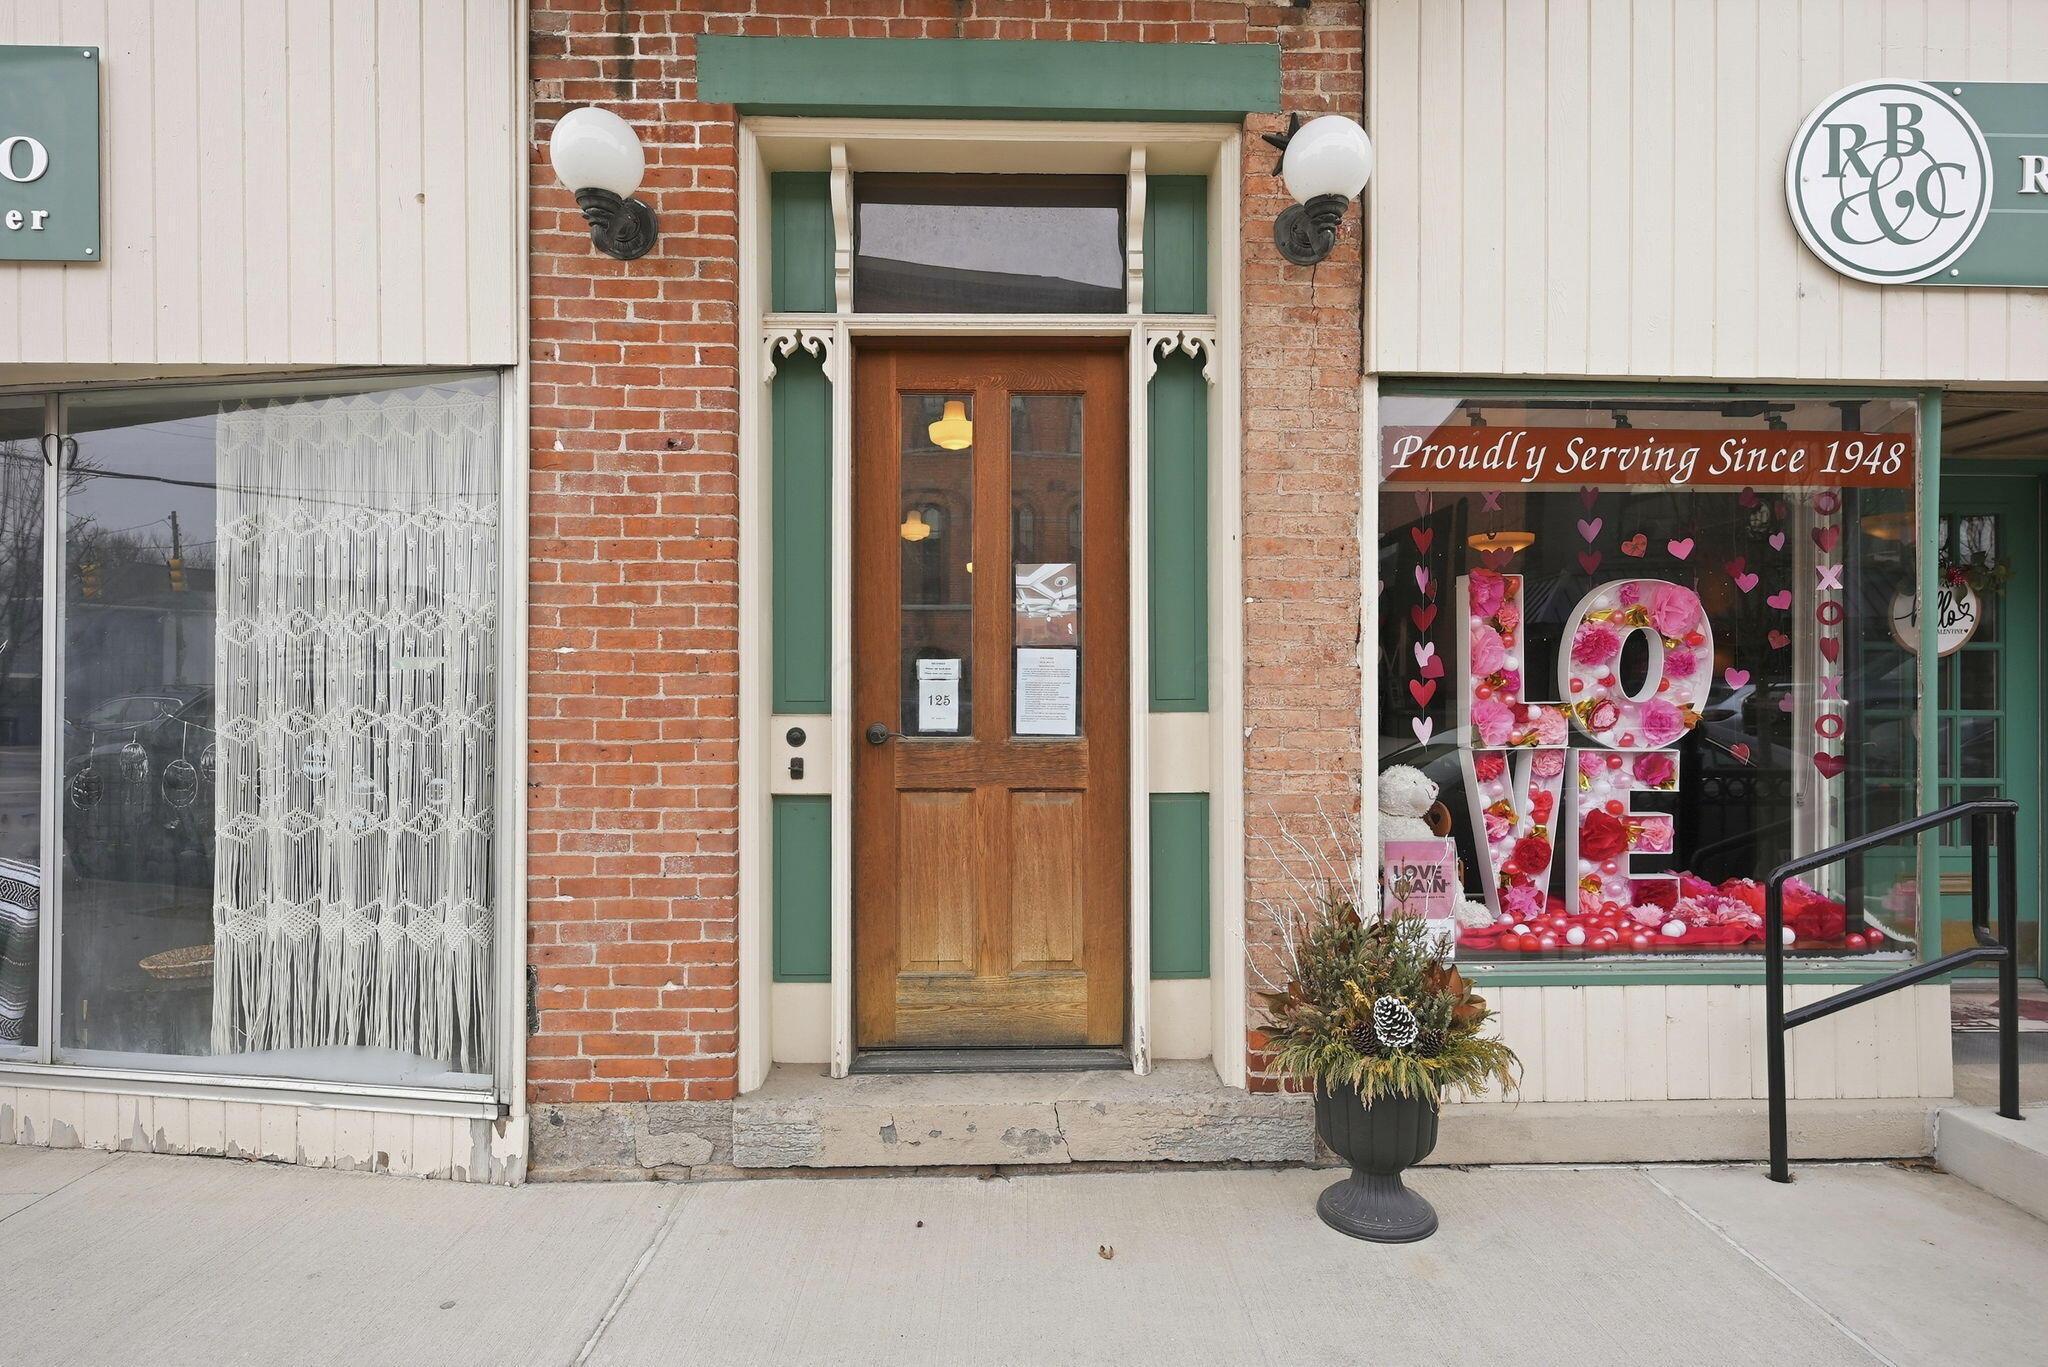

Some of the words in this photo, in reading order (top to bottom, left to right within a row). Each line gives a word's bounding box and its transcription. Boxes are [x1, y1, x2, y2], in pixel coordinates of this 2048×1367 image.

[1390, 431, 1547, 483] Proudly
[1555, 436, 1700, 484] Serving
[1708, 437, 1805, 475] Since
[1819, 440, 1906, 475] 1948
[928, 694, 951, 706] 125
[1395, 879, 1446, 893] AIN
